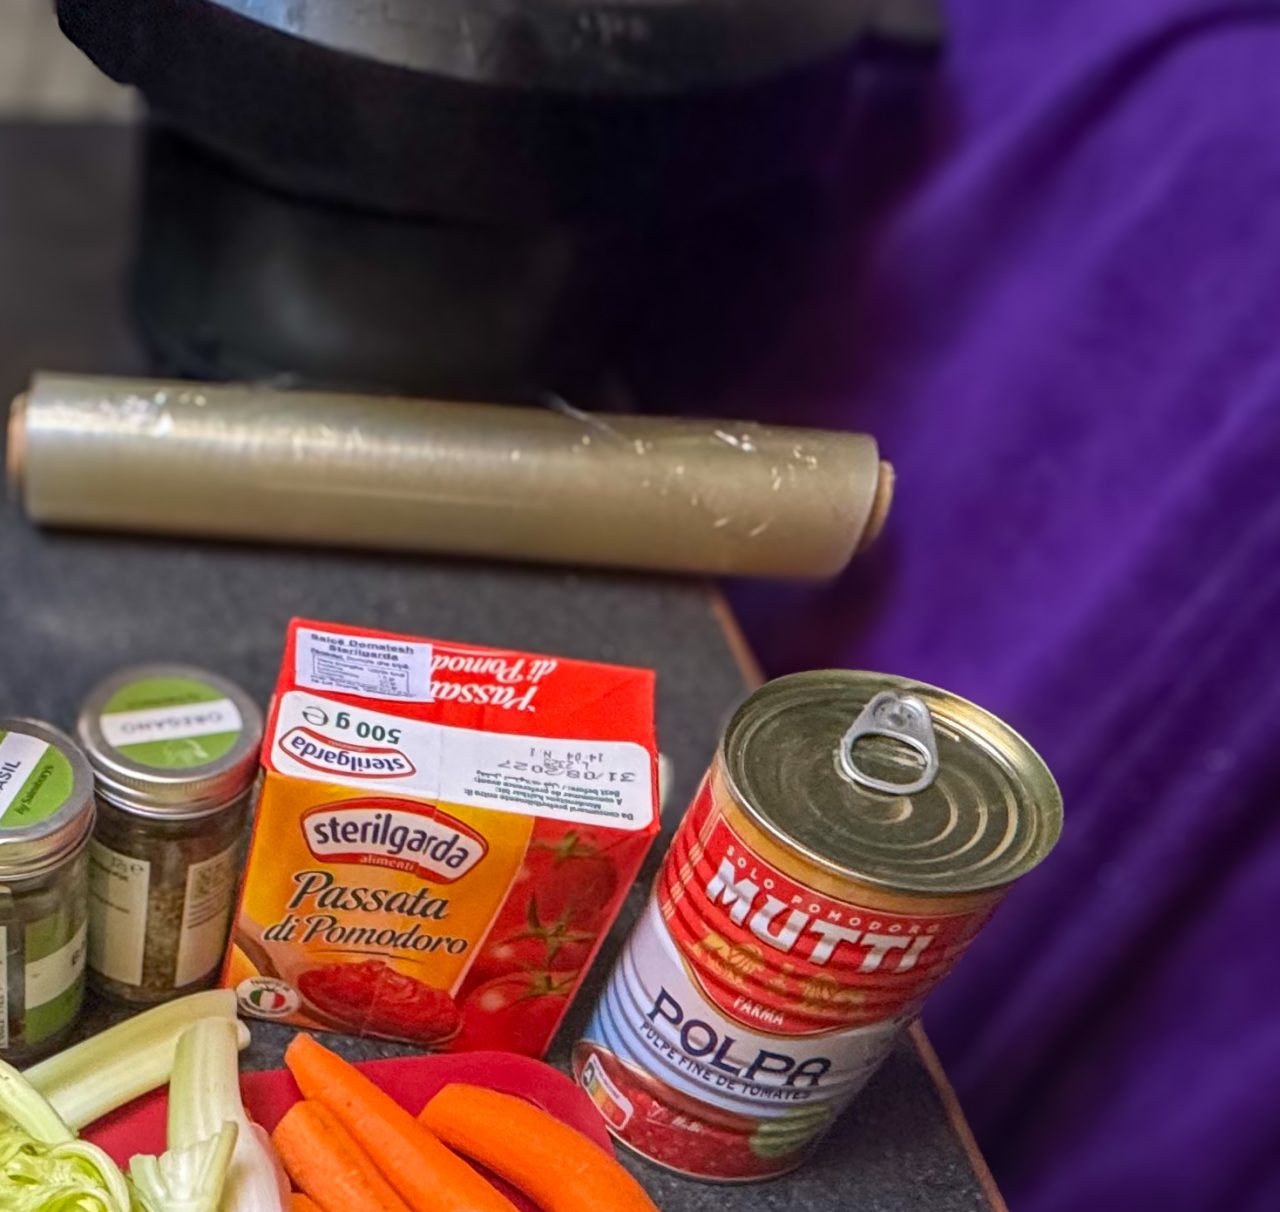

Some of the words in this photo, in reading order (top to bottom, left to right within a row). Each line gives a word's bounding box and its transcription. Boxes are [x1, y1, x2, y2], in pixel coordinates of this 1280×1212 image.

[526, 659, 558, 683] di
[121, 711, 223, 735] OREGANO
[335, 711, 351, 730] g
[356, 721, 402, 745] 500
[291, 735, 406, 772] sterilgarda
[497, 760, 636, 783] 31/08/2027
[314, 812, 469, 869] sterilgarda
[359, 854, 415, 872] alimenti
[286, 870, 450, 920] Passata
[726, 845, 776, 889] SOLO
[790, 894, 940, 934] POMODORO
[705, 856, 934, 974] MUTTI
[263, 914, 301, 942] di
[302, 914, 469, 955] Pomodoro
[733, 995, 785, 1027] PARMA
[647, 986, 832, 1087] POLPA
[639, 1020, 676, 1060] PULPE
[679, 1054, 712, 1082] FINE
[716, 1074, 737, 1092] DE
[740, 1080, 812, 1101] TOMATES
